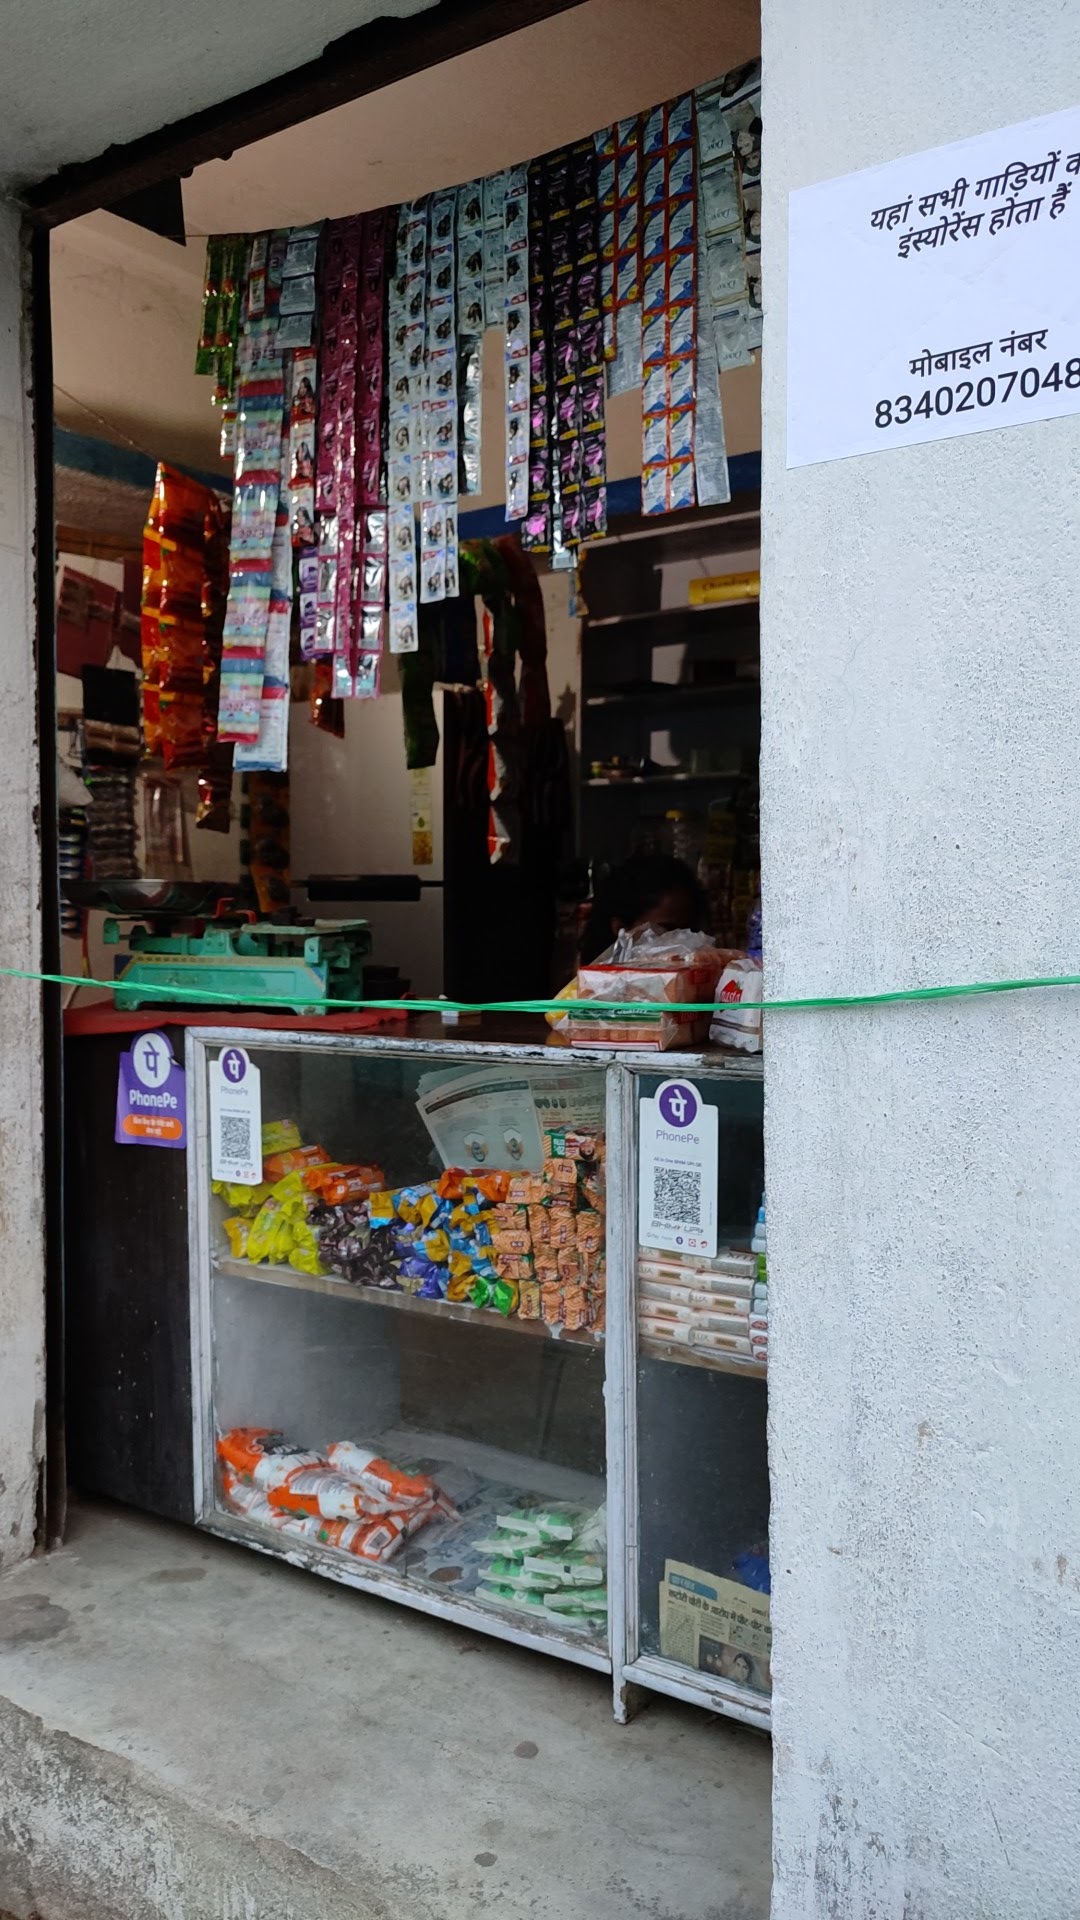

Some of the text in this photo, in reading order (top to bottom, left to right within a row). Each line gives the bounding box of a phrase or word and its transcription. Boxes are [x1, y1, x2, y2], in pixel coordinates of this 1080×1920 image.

[870, 194, 914, 231] यहां
[918, 177, 970, 217] सभी
[974, 149, 1062, 200] गाड़ियों
[897, 181, 1073, 259] इंस्योरेंस होता हैं
[909, 329, 1048, 378] मोबाइल नंबर
[873, 357, 1080, 429] 8340207048
[129, 1089, 178, 1109] PhonePe
[669, 1088, 687, 1122] पे
[656, 1129, 700, 1145] PhonePe
